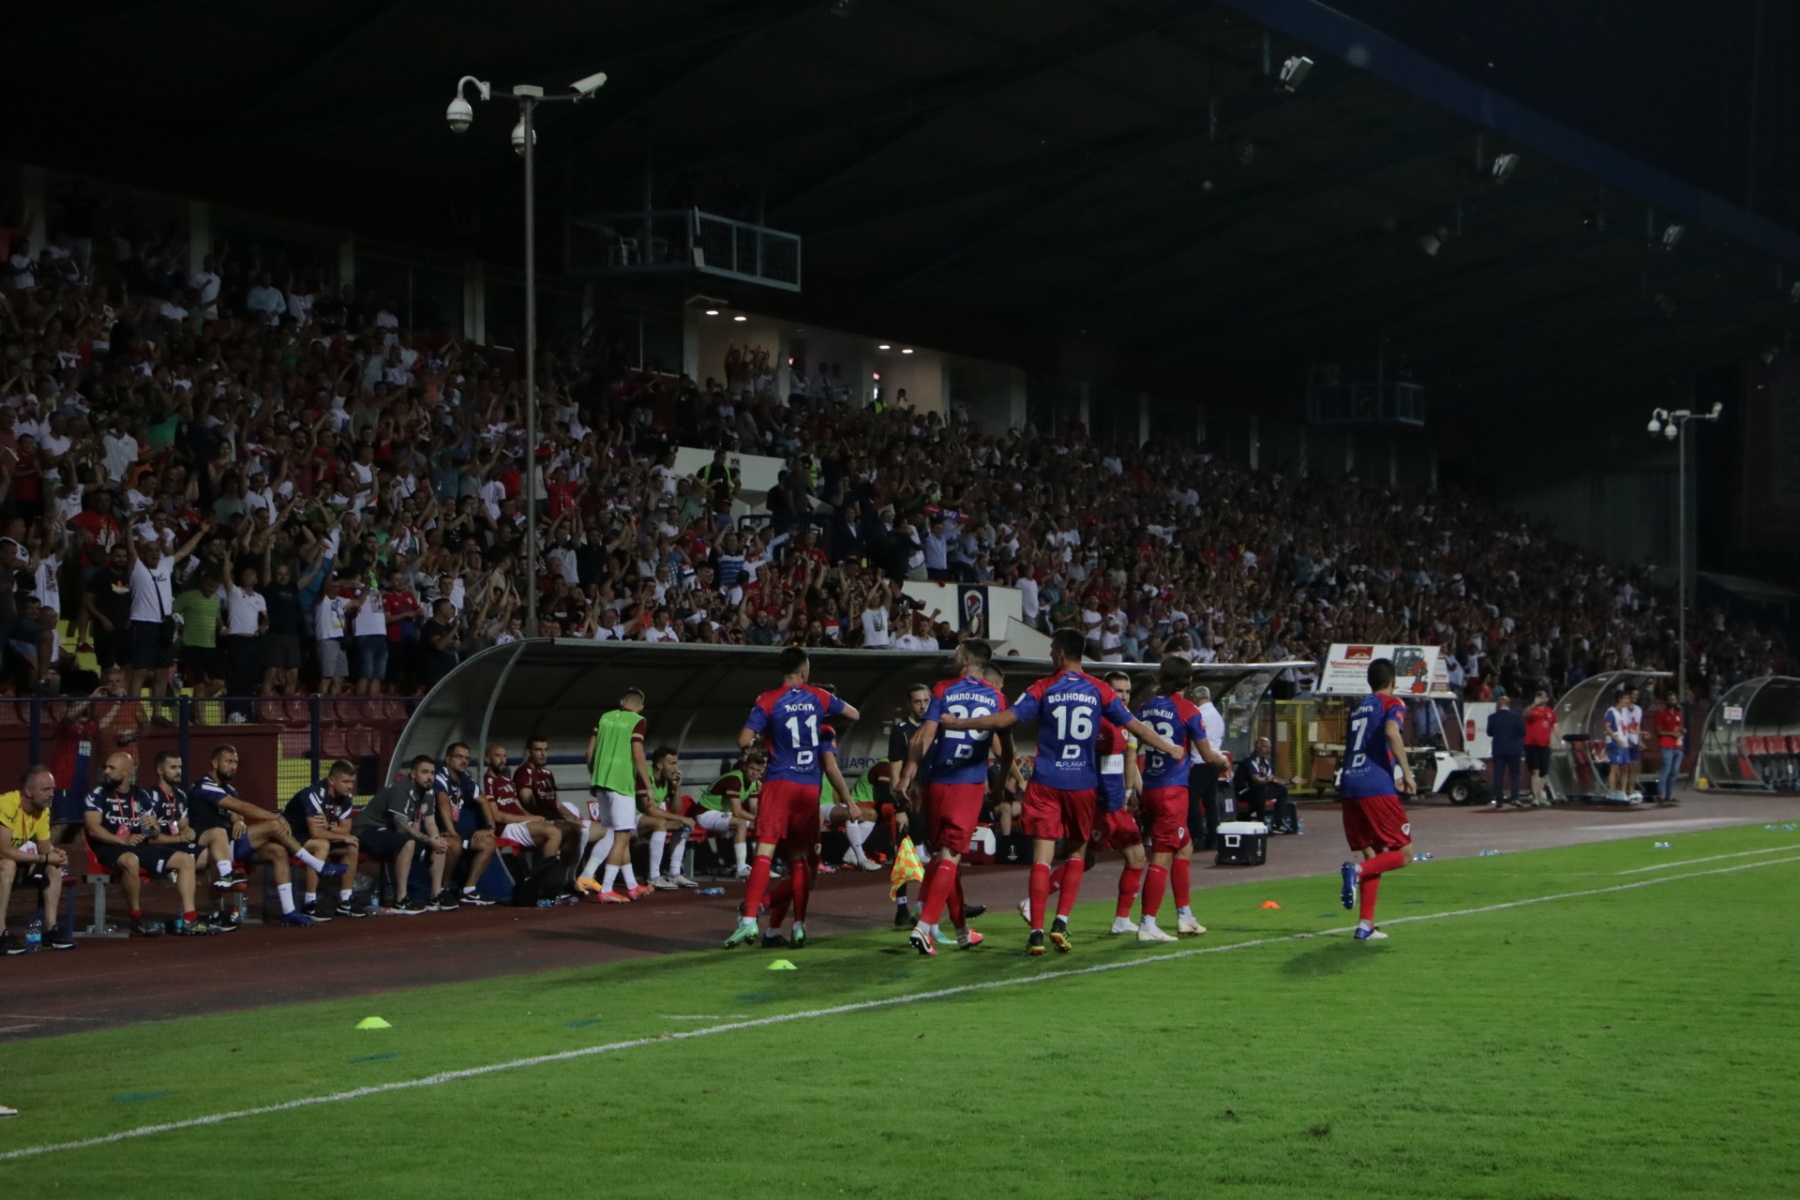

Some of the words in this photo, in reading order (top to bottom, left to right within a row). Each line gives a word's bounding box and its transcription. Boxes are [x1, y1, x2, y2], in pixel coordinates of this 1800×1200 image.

[946, 693, 996, 708] МИЛОЈЕВИЋ
[1048, 693, 1097, 706] ВОЈНОВИЋ
[785, 714, 819, 748] 11
[1051, 705, 1093, 740] 16
[1351, 717, 1368, 751] 7
